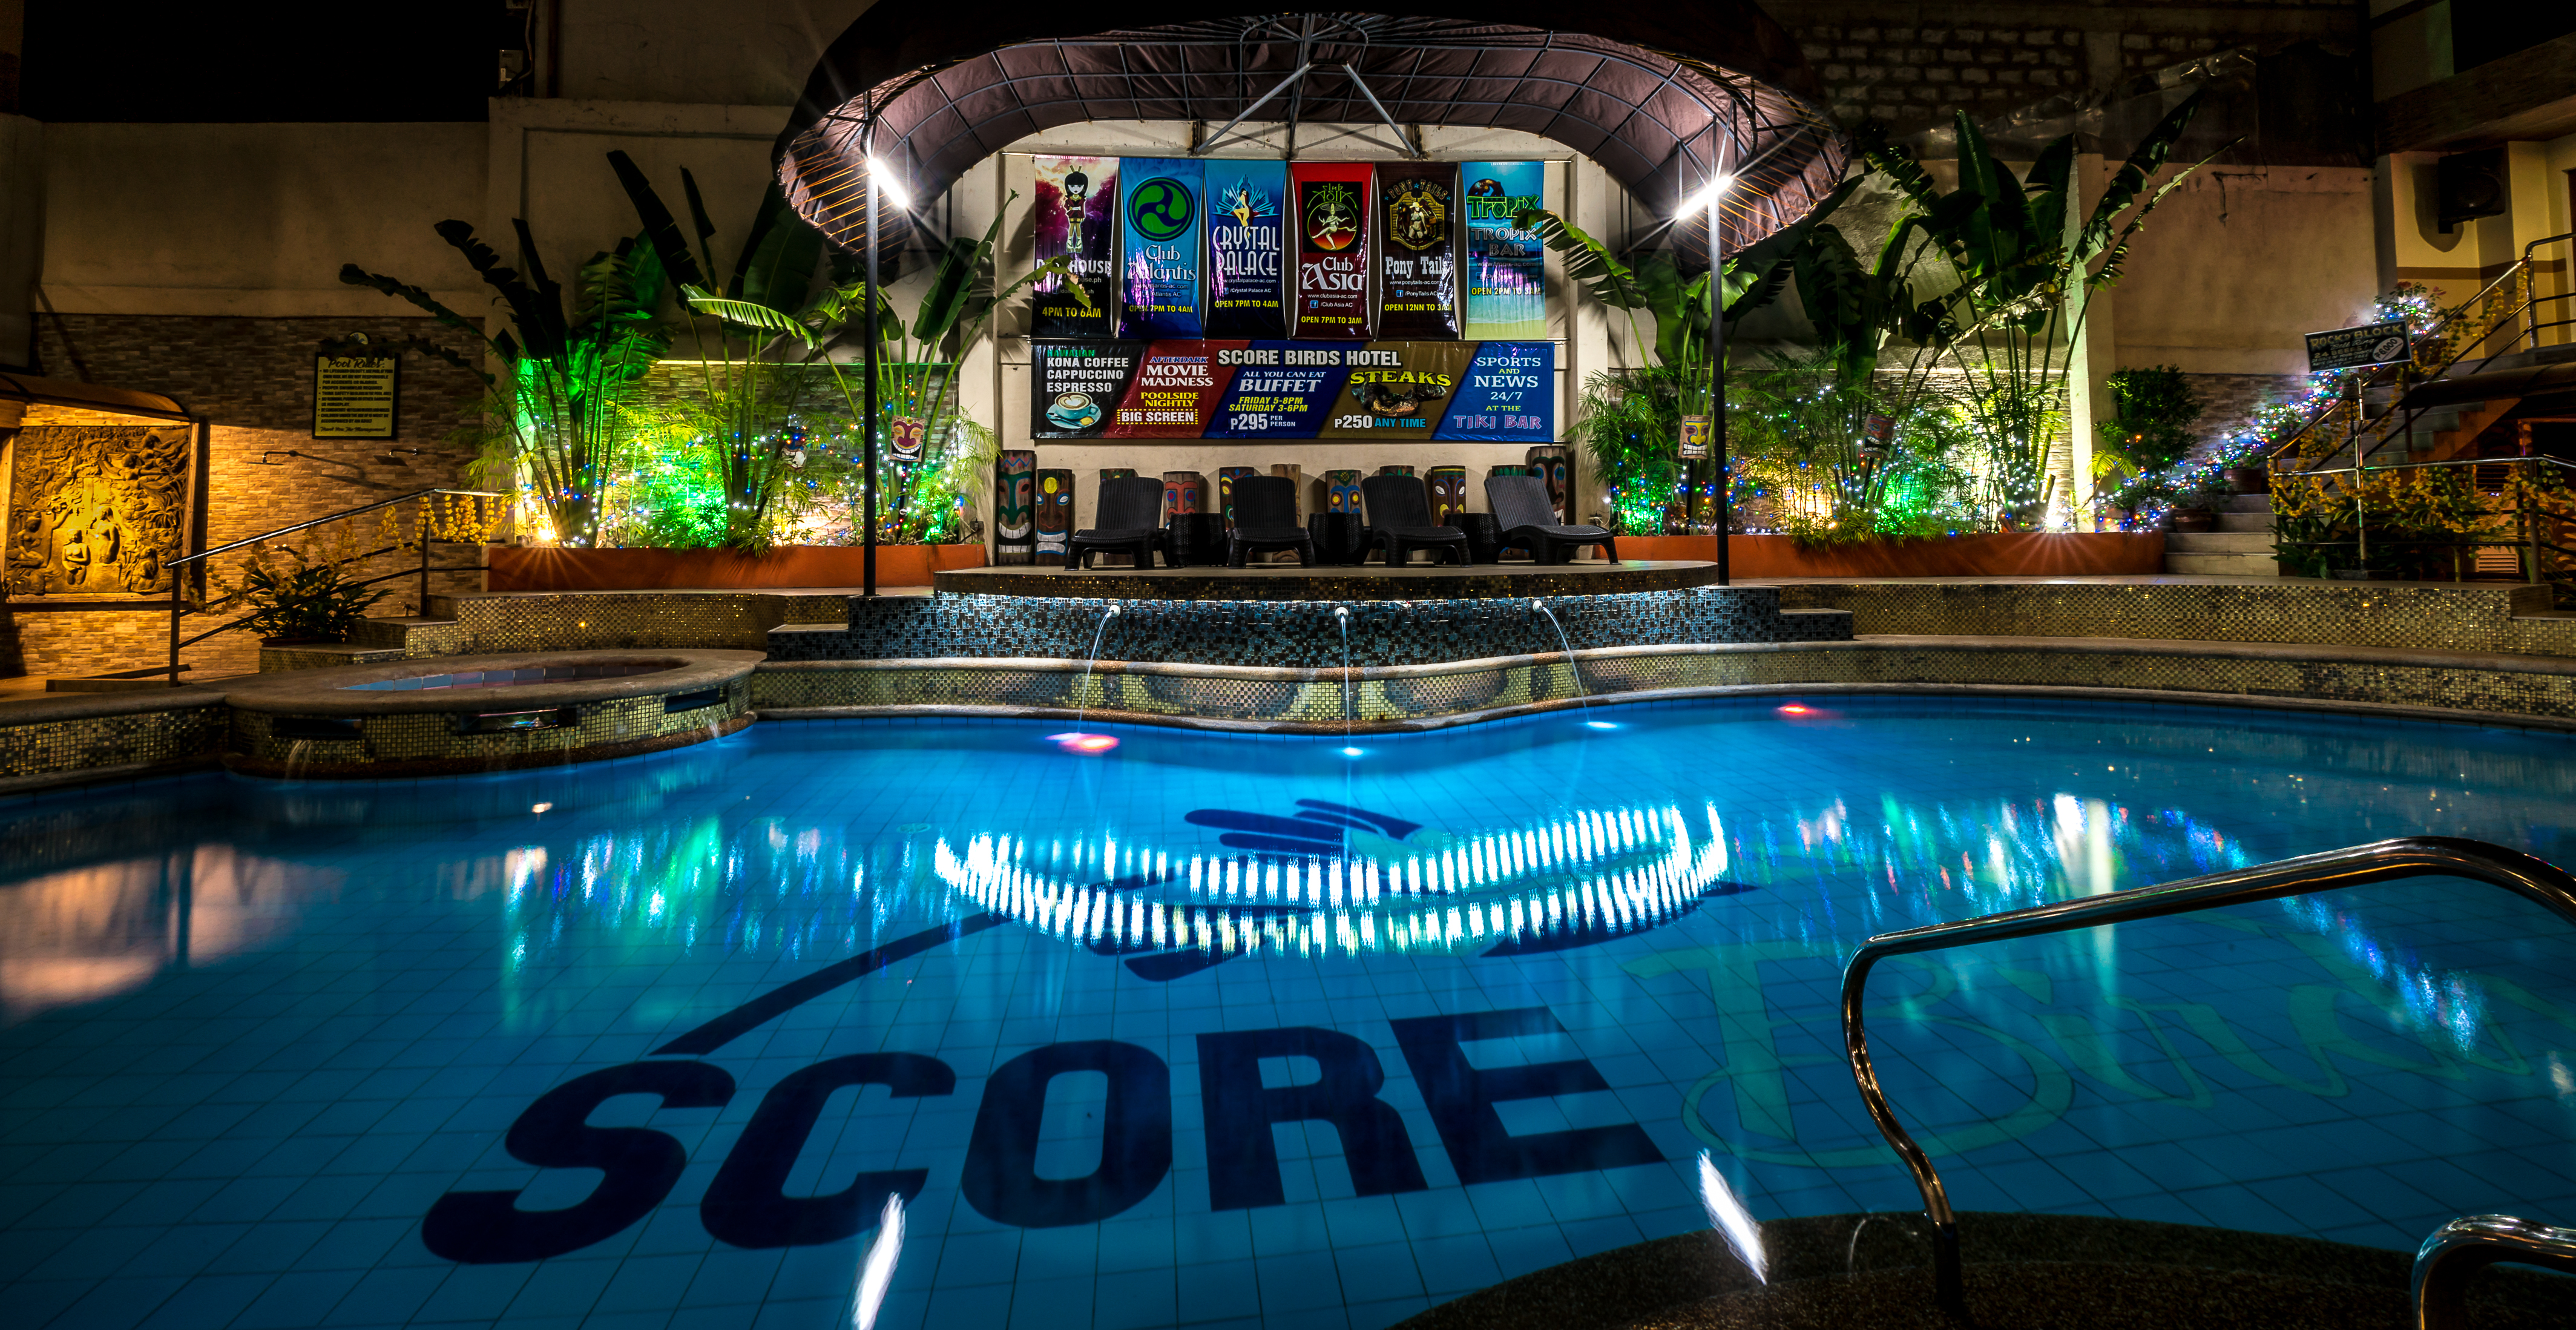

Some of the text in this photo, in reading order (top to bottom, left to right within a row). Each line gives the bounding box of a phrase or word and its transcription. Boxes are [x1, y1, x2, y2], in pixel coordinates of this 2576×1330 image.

[1387, 179, 1448, 200] PONY TAILS
[1212, 225, 1280, 251] CRYSTAL
[1145, 245, 1180, 260] Club
[1489, 243, 1526, 257] BAR
[1216, 251, 1277, 276] PALACE
[1322, 257, 1353, 271] Club
[1385, 256, 1447, 278] Pony Tails
[1127, 262, 1197, 280] Atlantis
[1042, 307, 1102, 318] 4PM TO 6AM
[2354, 324, 2402, 339] BLOCK
[328, 358, 351, 368] Pool
[1046, 358, 1128, 367] KONA COFFEE
[1218, 349, 1401, 366] SCORE BIRDS HOTEL
[1476, 357, 1541, 367] SPORTS
[1046, 369, 1123, 380] CAPPUCCINO
[1146, 365, 1208, 376] MOVIE
[1141, 377, 1214, 386] MADNESS
[1239, 378, 1322, 392] BUFFET
[1350, 371, 1451, 386] STEAKS
[1474, 375, 1539, 387] NEWS
[1046, 382, 1112, 392] ESPRESSO
[1490, 392, 1522, 401] 24/7
[1228, 404, 1274, 412] SATURDAY
[1122, 412, 1194, 422] BIG SCREEN
[1374, 418, 1396, 427] ANY
[1399, 418, 1426, 428] TIME
[1453, 415, 1542, 430] TIKI BAR
[421, 1006, 1667, 1265] SCORE
